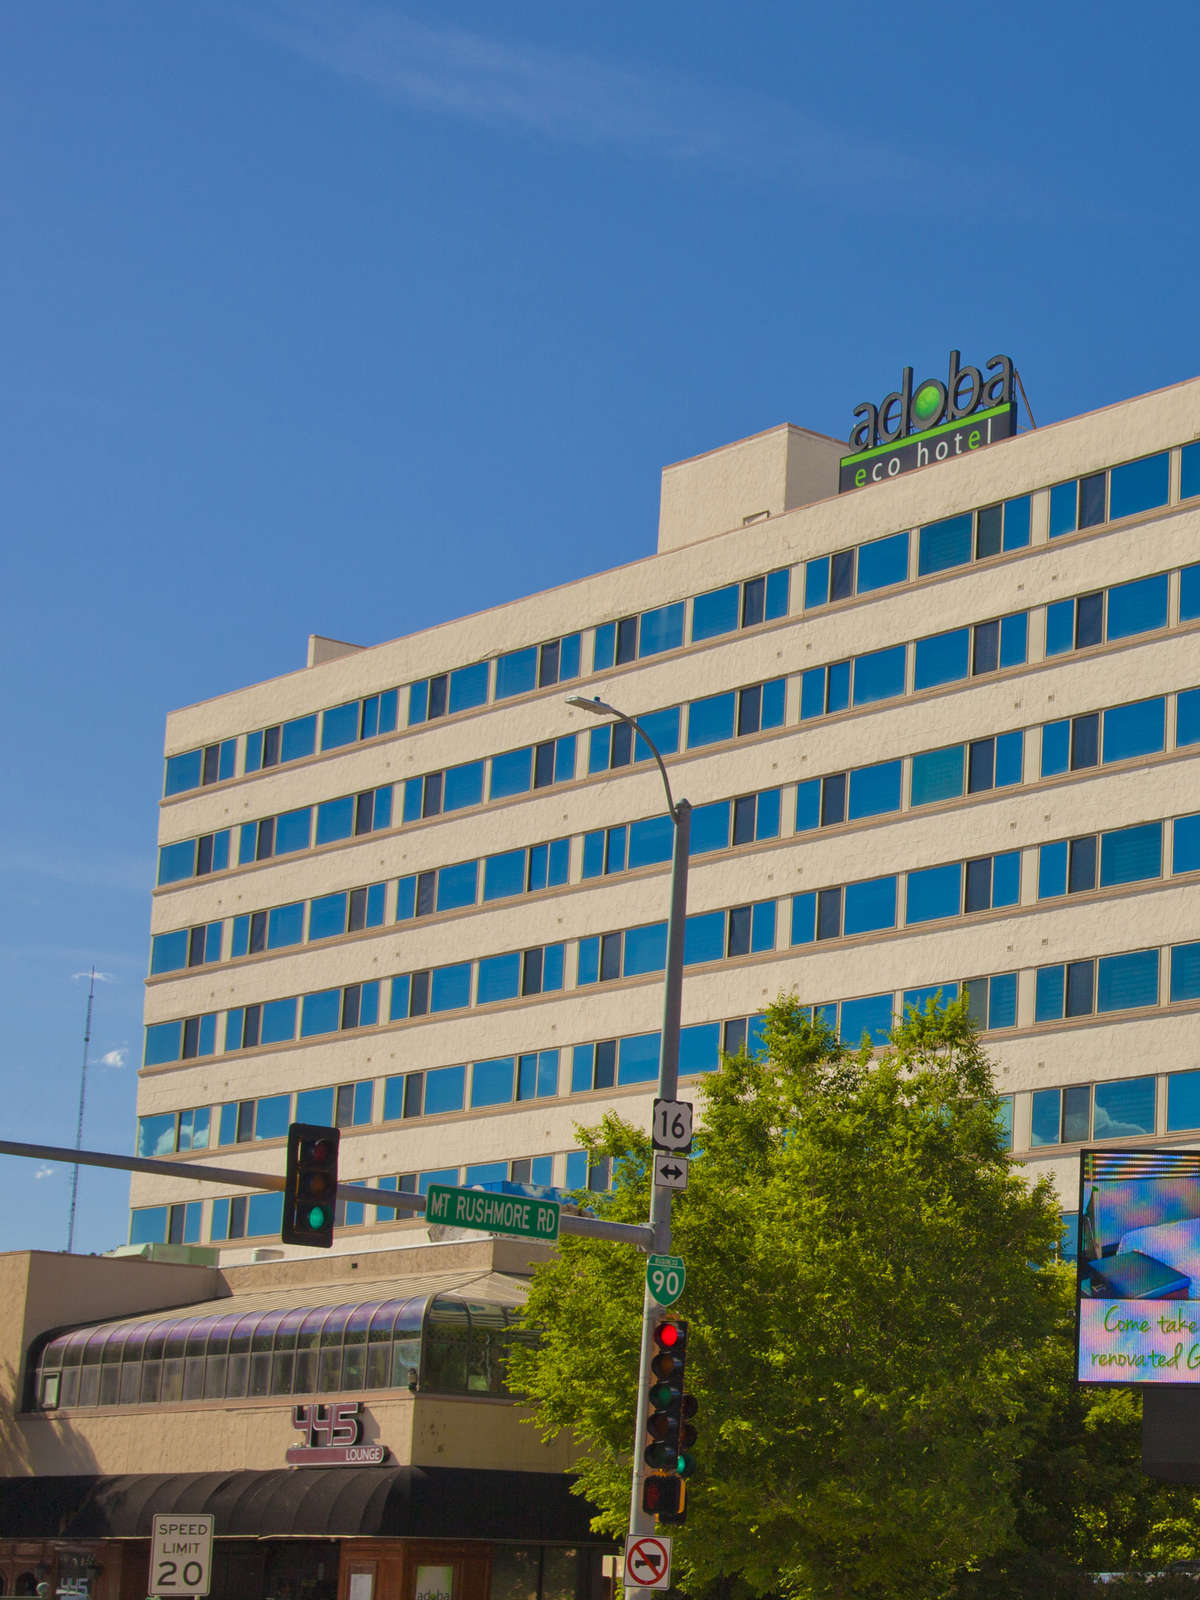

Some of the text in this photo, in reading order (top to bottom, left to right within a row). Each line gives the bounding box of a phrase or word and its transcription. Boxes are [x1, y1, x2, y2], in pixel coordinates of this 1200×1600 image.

[850, 350, 1014, 452] adoba
[855, 418, 992, 488] eco hotel
[662, 1110, 685, 1138] 16
[430, 1191, 555, 1232] MT RUSHMORE RD
[652, 1270, 679, 1295] 90
[1104, 1305, 1151, 1334] Come
[1157, 1307, 1199, 1335] take
[1091, 1342, 1183, 1370] renovated
[291, 1402, 362, 1447] 445
[345, 1447, 381, 1461] LOUNGE
[159, 1523, 208, 1536] SPEED
[163, 1542, 201, 1554] LIMIT
[157, 1561, 203, 1586] 20
